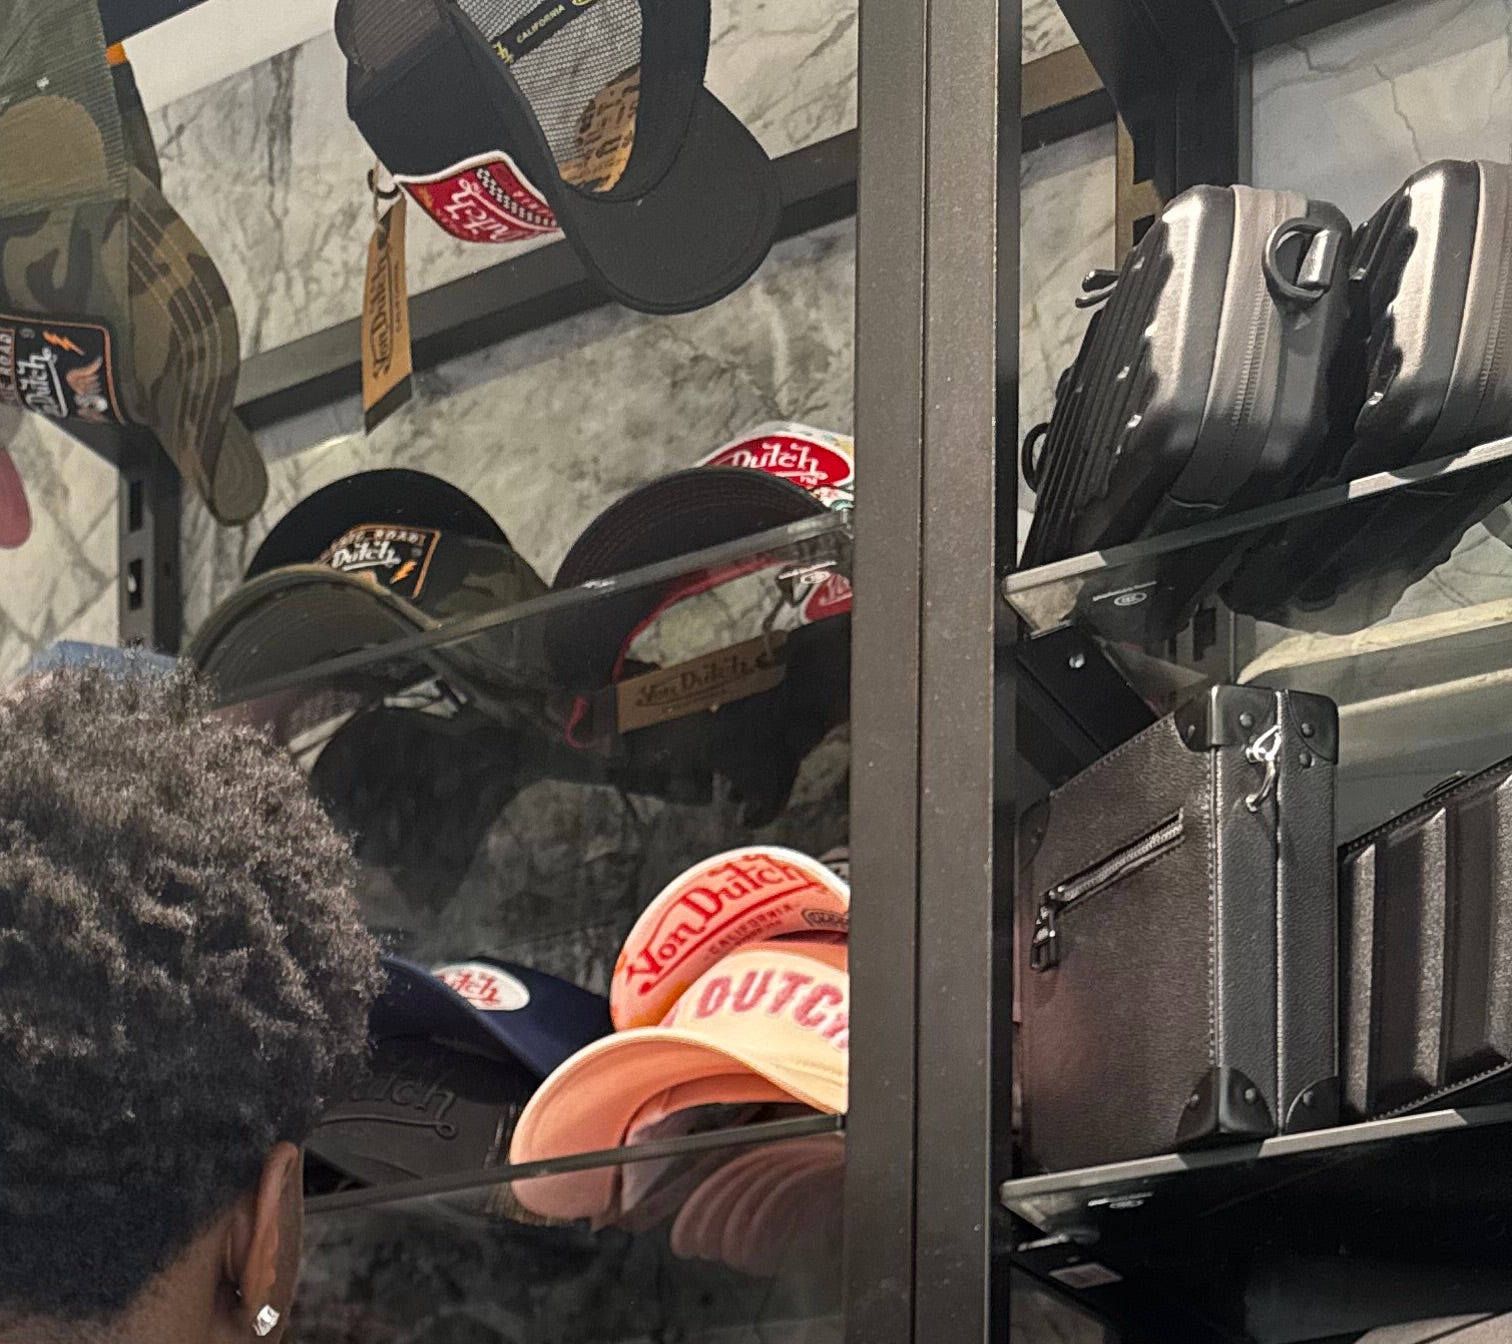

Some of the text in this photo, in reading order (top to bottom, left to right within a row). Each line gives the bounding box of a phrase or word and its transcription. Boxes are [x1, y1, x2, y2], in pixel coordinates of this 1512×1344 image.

[680, 655, 756, 691] Dutch
[624, 920, 707, 986] Von
[680, 854, 818, 925] Dutch
[708, 902, 796, 956] CALIFORNIA
